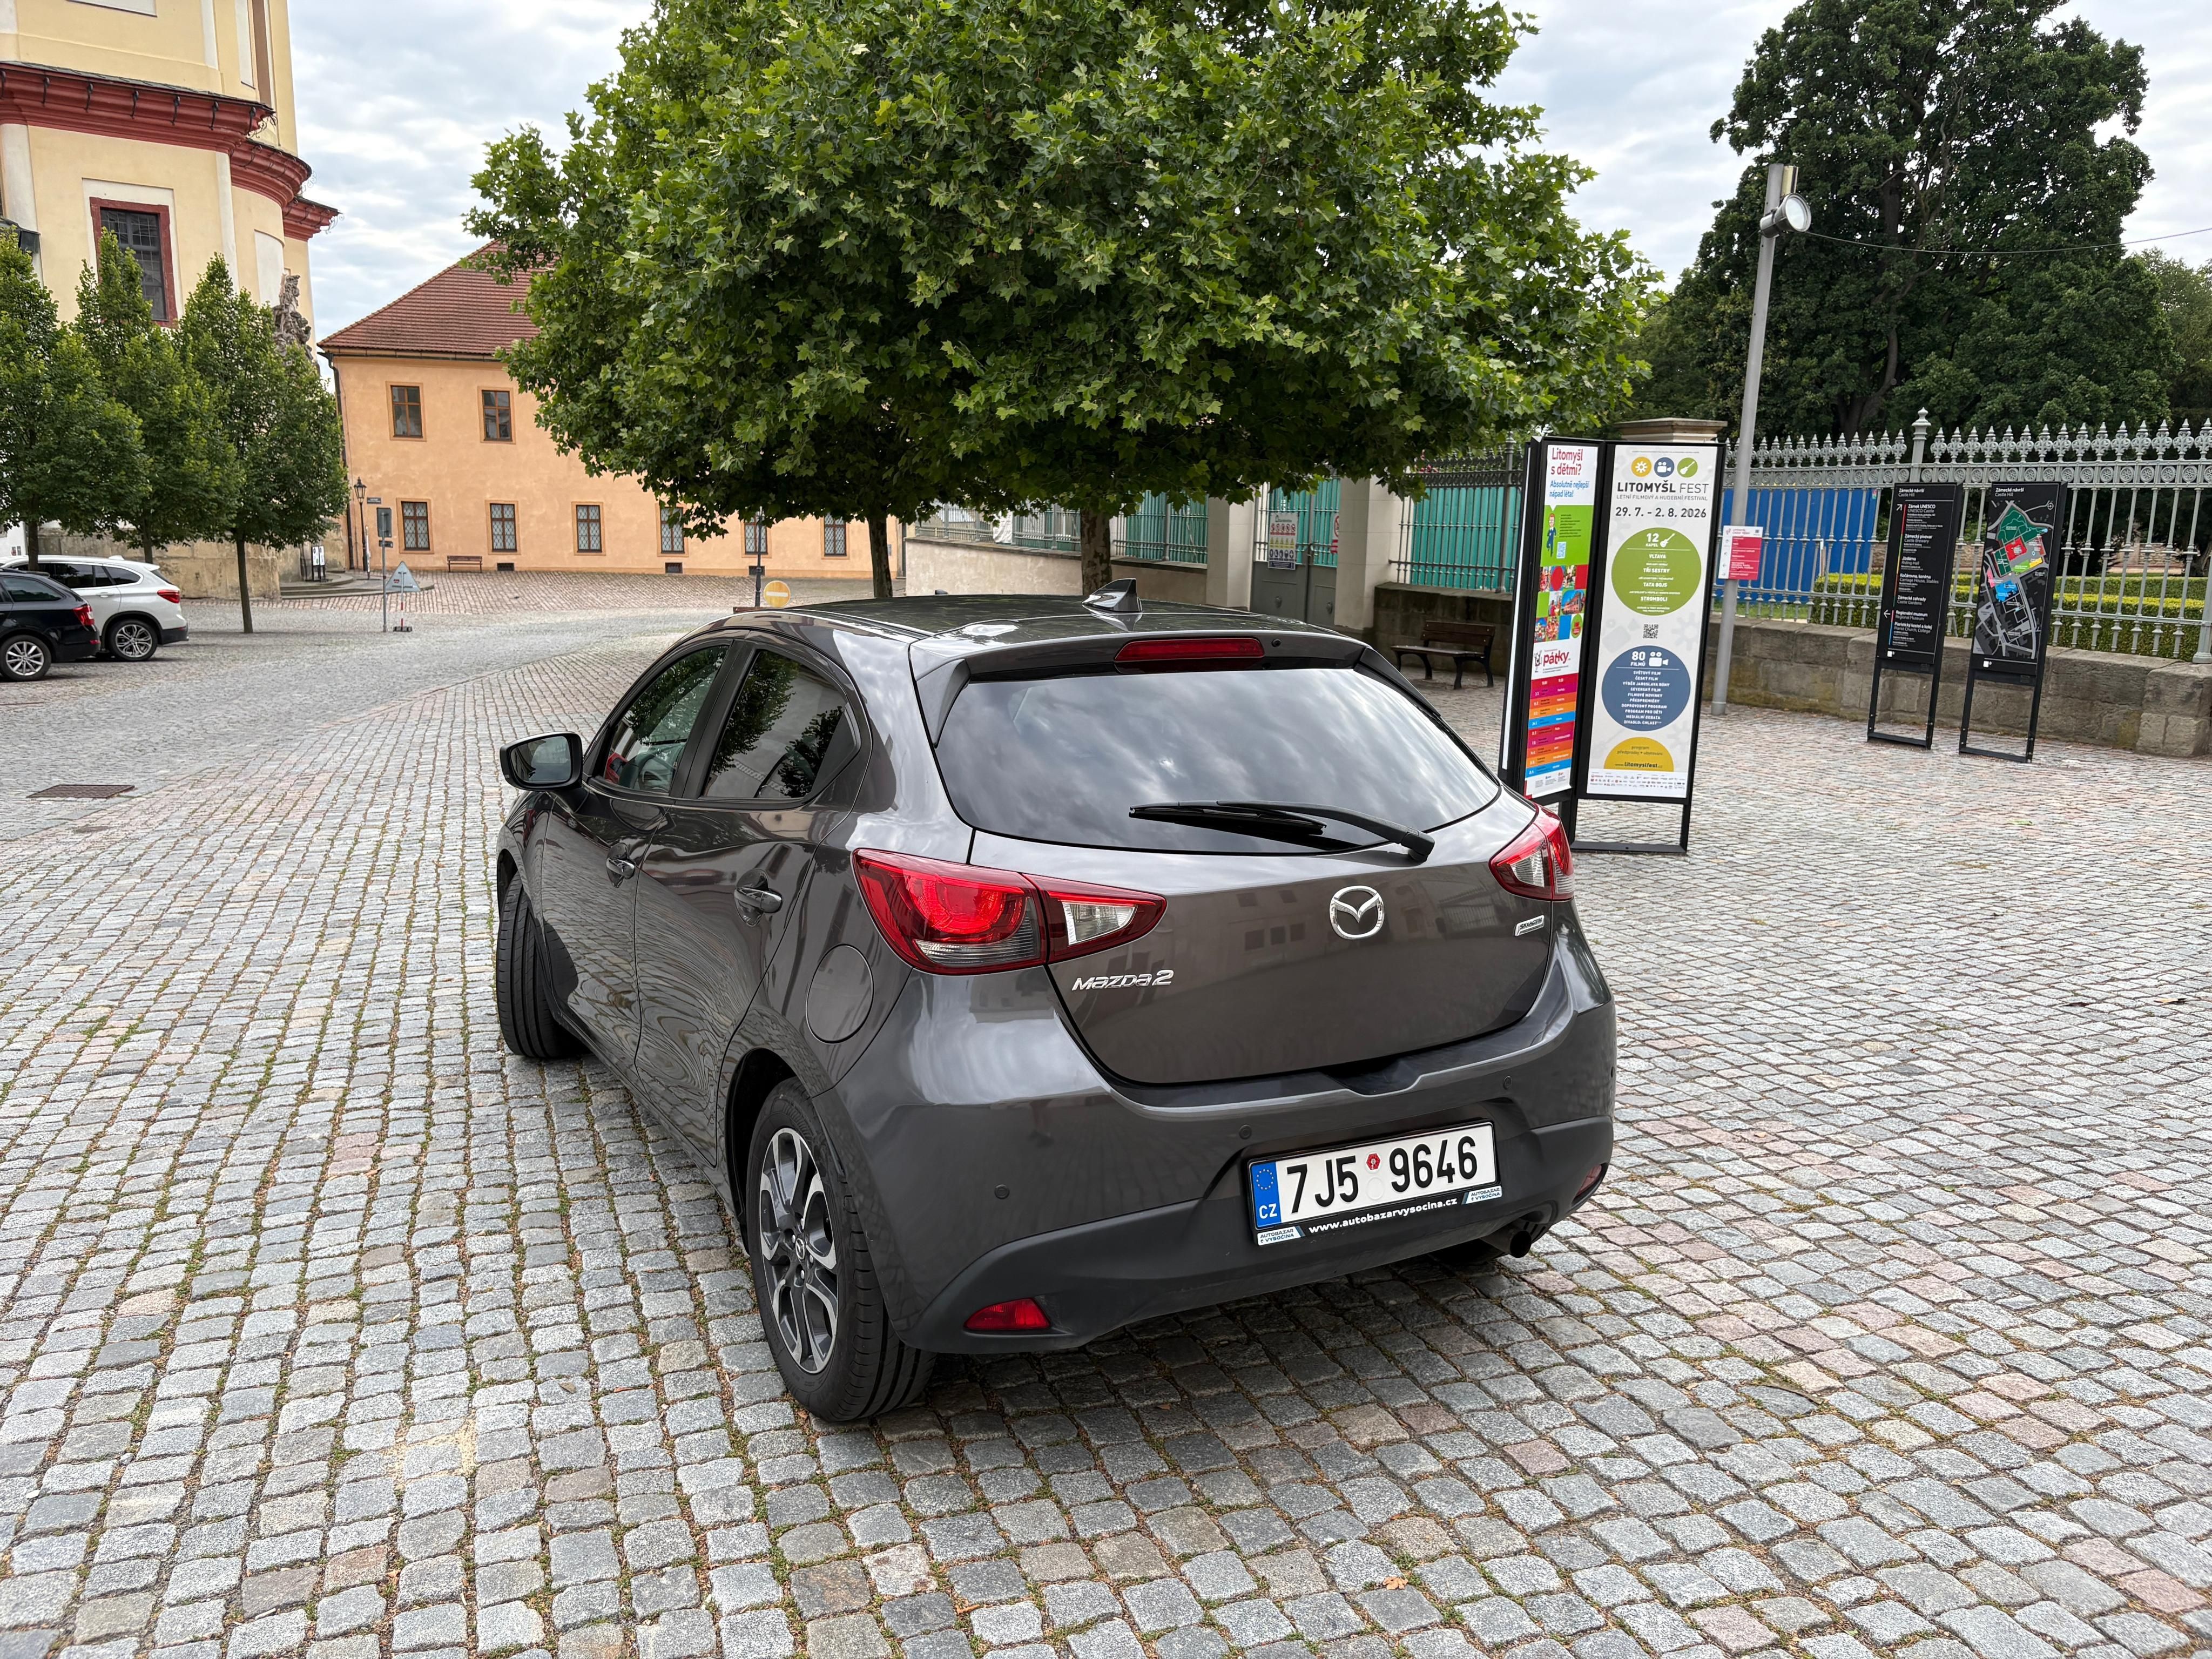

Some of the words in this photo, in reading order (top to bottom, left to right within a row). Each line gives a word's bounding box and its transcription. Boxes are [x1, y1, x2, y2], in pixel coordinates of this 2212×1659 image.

[1552, 447, 1583, 464] Litomyšl
[1551, 466, 1555, 475] s
[1557, 463, 1582, 475] dětmi?
[1573, 481, 1590, 489] nejlepší
[1617, 480, 1676, 493] LITOMYŠL
[1680, 483, 1709, 494] FEST
[1549, 490, 1563, 499] nápad
[1615, 507, 1631, 516] 29.
[1635, 507, 1644, 516] 7.
[1655, 508, 1664, 517] 2.
[1668, 508, 1677, 517] 8.
[1681, 508, 1707, 518] 2026
[1646, 533, 1659, 543] 12
[1543, 650, 1569, 666] pátky
[1631, 651, 1645, 660] 80
[1520, 918, 1543, 928] SKYACTIV
[1286, 1155, 1359, 1213] 7J5
[1389, 1136, 1477, 1192] 9646
[1475, 1192, 1500, 1200] VYSOČINA
[1259, 1203, 1278, 1219] CZ
[1309, 1198, 1458, 1234] www.autobazarvysocina.cz
[1260, 1229, 1294, 1238] AUTOBAZAR
[1265, 1233, 1294, 1242] VYSOČINA
